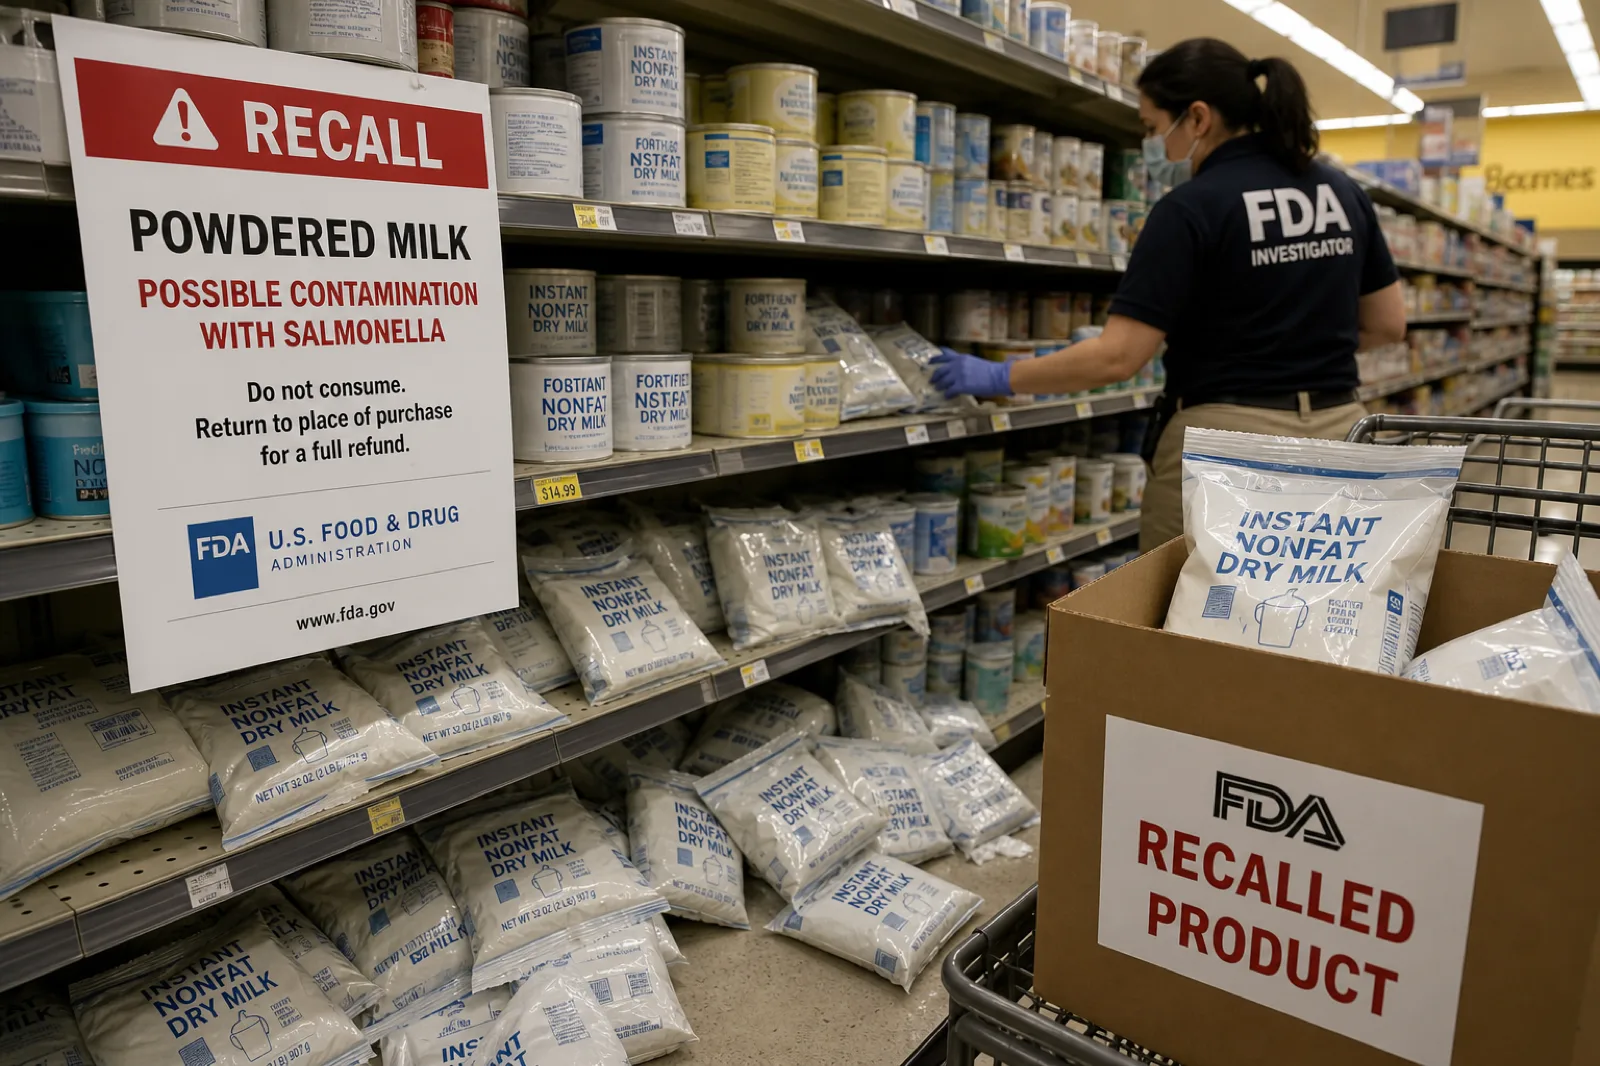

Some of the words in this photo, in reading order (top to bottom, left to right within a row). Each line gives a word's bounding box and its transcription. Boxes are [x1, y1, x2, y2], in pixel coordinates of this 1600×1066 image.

[631, 60, 678, 77] NONFAT
[633, 45, 678, 63] INSTANT
[634, 76, 658, 88] DRY
[660, 78, 679, 91] MILK
[243, 100, 443, 169] RECALL
[633, 168, 658, 180] DRY
[660, 168, 681, 181] MILK
[1242, 183, 1351, 243] FDA
[129, 208, 376, 259] POWDERED
[387, 221, 472, 261] MILK
[1251, 237, 1354, 267] INVESTIGATOR
[138, 278, 282, 308] POSSIBLE
[290, 280, 479, 308] CONTAMINATION
[528, 284, 589, 300] INSTANT
[527, 302, 589, 320] NONFAT
[532, 319, 560, 334] DRY
[564, 319, 589, 334] MILK
[745, 320, 768, 333] DRY
[199, 321, 276, 350] WITH
[284, 318, 446, 347] SALMONELLA
[247, 380, 275, 403] Do
[281, 380, 314, 401] not
[319, 378, 407, 400] consume.
[542, 395, 607, 415] NONFAT
[195, 413, 268, 440] Return
[272, 413, 293, 434] to
[298, 408, 349, 436] place
[353, 405, 372, 428] of
[376, 402, 454, 430] purchase
[547, 416, 577, 432] DRY
[581, 414, 607, 430] MILK
[640, 410, 667, 424] DRY
[669, 408, 690, 422] MILK
[260, 444, 290, 467] for
[295, 447, 307, 463] a
[312, 439, 343, 462] full
[348, 434, 411, 459] refund.
[541, 483, 576, 501] $14.99
[268, 527, 314, 550] U.S.
[321, 516, 378, 543] FOOD
[386, 514, 401, 532] &
[407, 505, 460, 530] DRUG
[1239, 510, 1383, 537] INSTANT
[197, 532, 251, 562] FDA
[271, 537, 412, 572] ADMINISTRATION
[762, 550, 812, 567] INSTANT
[1235, 531, 1367, 561] NONFAT
[768, 565, 815, 584] NONFAT
[1215, 552, 1283, 583] DRY
[1287, 561, 1369, 584] MILK
[580, 575, 644, 599] INSTANT
[592, 588, 653, 613] NONFAT
[771, 586, 794, 600] DRY
[796, 580, 823, 595] MILK
[296, 599, 396, 631] www.fda.gov
[602, 610, 632, 628] DRY
[635, 600, 669, 621] MILK
[396, 639, 470, 673] INSTANT
[403, 652, 475, 684] NONFAT
[410, 677, 446, 696] DRY
[449, 663, 491, 684] MILK
[220, 679, 313, 717] INSTANT
[230, 691, 321, 730] NONFAT
[240, 724, 284, 746] DRY
[290, 700, 341, 728] MILK
[422, 731, 439, 743] NET
[439, 728, 451, 740] WT
[255, 788, 275, 805] NET
[275, 782, 290, 797] WT
[291, 777, 303, 790] 32
[315, 768, 325, 783] (2
[758, 765, 812, 803] INSTANT
[771, 777, 820, 814] NONFAT
[782, 805, 806, 826] DRY
[807, 785, 836, 811] MILK
[1213, 770, 1346, 852] FDA
[476, 813, 556, 849] INSTANT
[483, 828, 561, 863] NONFAT
[677, 815, 730, 845] NONFAT
[678, 830, 704, 849] DRY
[707, 840, 735, 862] MILK
[490, 856, 527, 879] DRY
[531, 841, 577, 866] MILK
[367, 887, 399, 911] DRY
[402, 863, 438, 890] MILK
[831, 861, 880, 904] INSTANT
[847, 866, 896, 910] NONFAT
[863, 892, 888, 917] DRY
[889, 872, 914, 897] MILK
[1137, 819, 1415, 944] RECALLED
[271, 917, 304, 939] ILK
[501, 917, 517, 932] NET
[517, 912, 531, 925] WT
[1147, 891, 1399, 1017] PRODUCT
[140, 939, 246, 1002] INSTANT
[152, 955, 257, 1018] NONFAT
[166, 1000, 221, 1040] DRY
[222, 970, 281, 1010] MILK
[289, 1044, 304, 1061] 907
[305, 1042, 312, 1054] g
